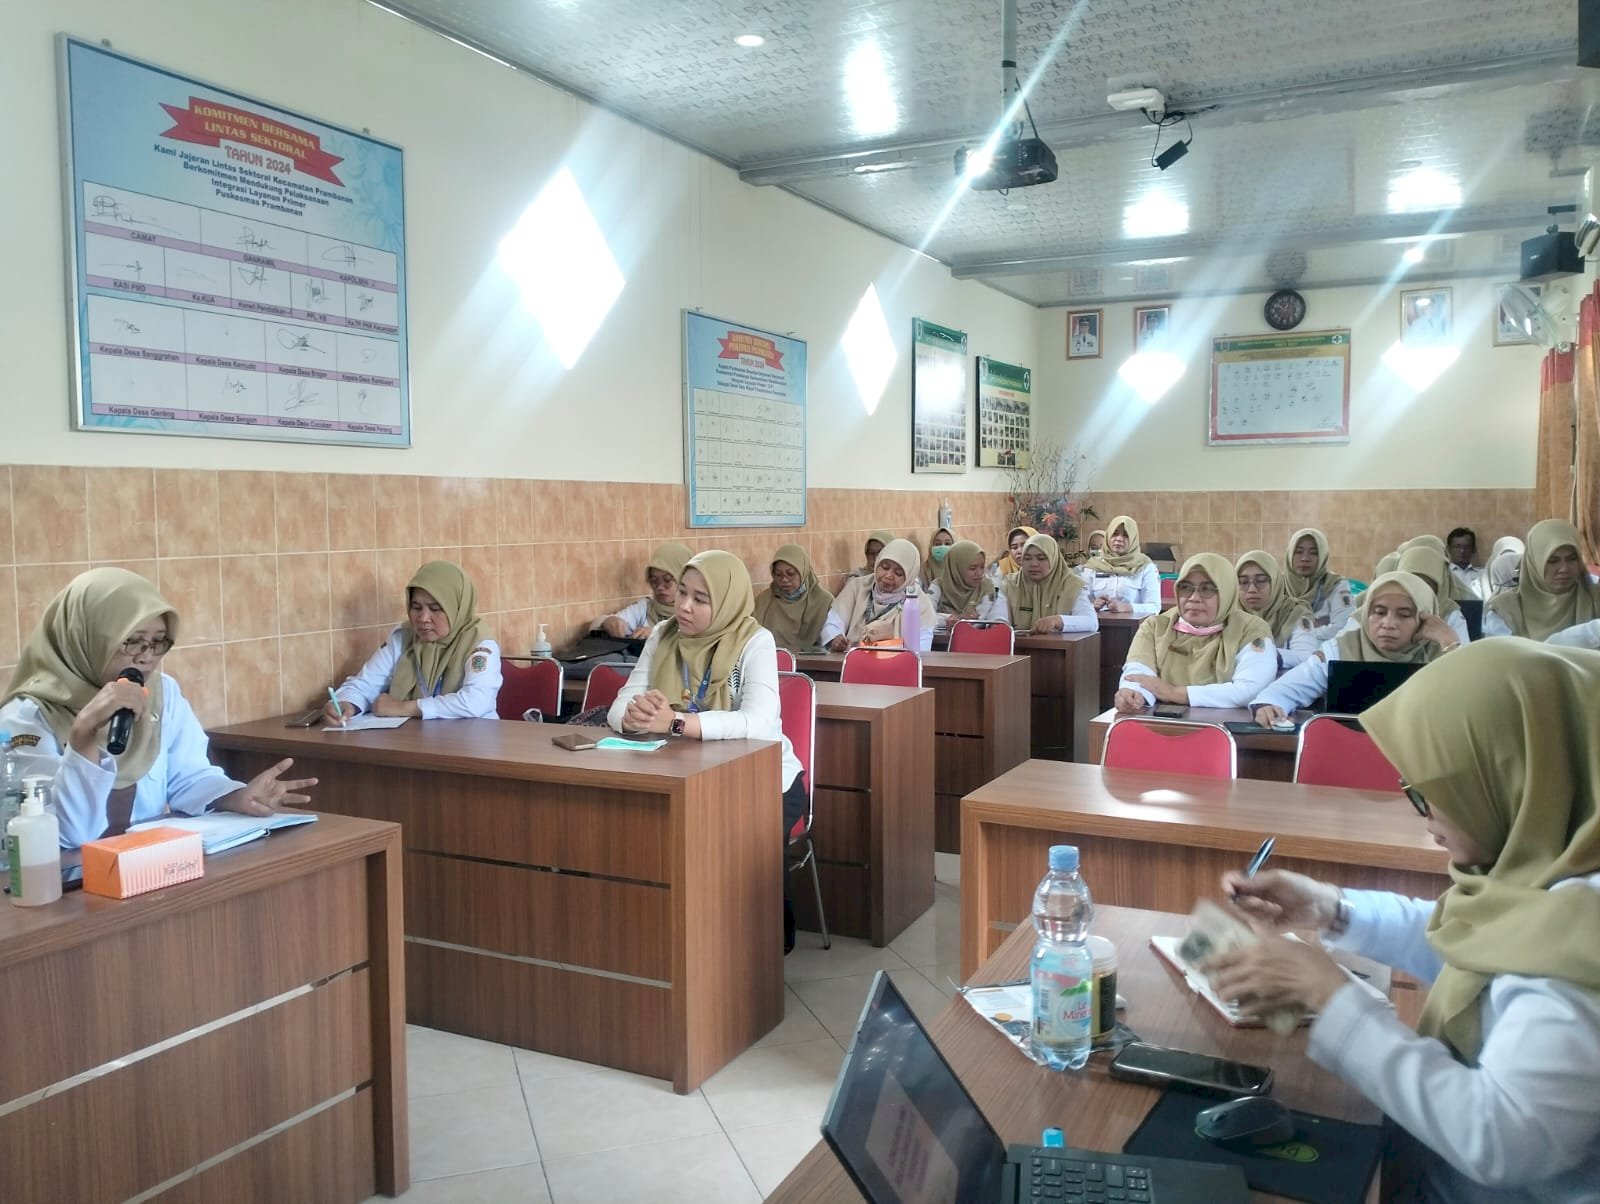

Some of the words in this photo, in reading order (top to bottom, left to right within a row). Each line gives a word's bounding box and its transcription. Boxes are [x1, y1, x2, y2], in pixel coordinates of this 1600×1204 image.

[194, 104, 258, 129] KOMITMEN
[262, 122, 316, 150] BERSAMA
[204, 121, 247, 140] LINTAS
[250, 132, 308, 160] SEKTORAL
[154, 143, 177, 157] Kami
[178, 151, 210, 166] Jajaran
[212, 159, 237, 173] Lintas
[239, 166, 271, 182] Sektoral
[273, 176, 314, 194] Kecamatan
[224, 145, 263, 168] TAHUN
[265, 157, 292, 175] 2024
[183, 161, 238, 182] Berkomitmen
[239, 176, 283, 196] Mendukung
[211, 178, 247, 194] Integrasi
[249, 187, 281, 201] Layanan
[215, 188, 260, 207] Puskesmas
[131, 231, 156, 242] CAMAT
[123, 348, 141, 358] Desa
[133, 407, 149, 416] Desa
